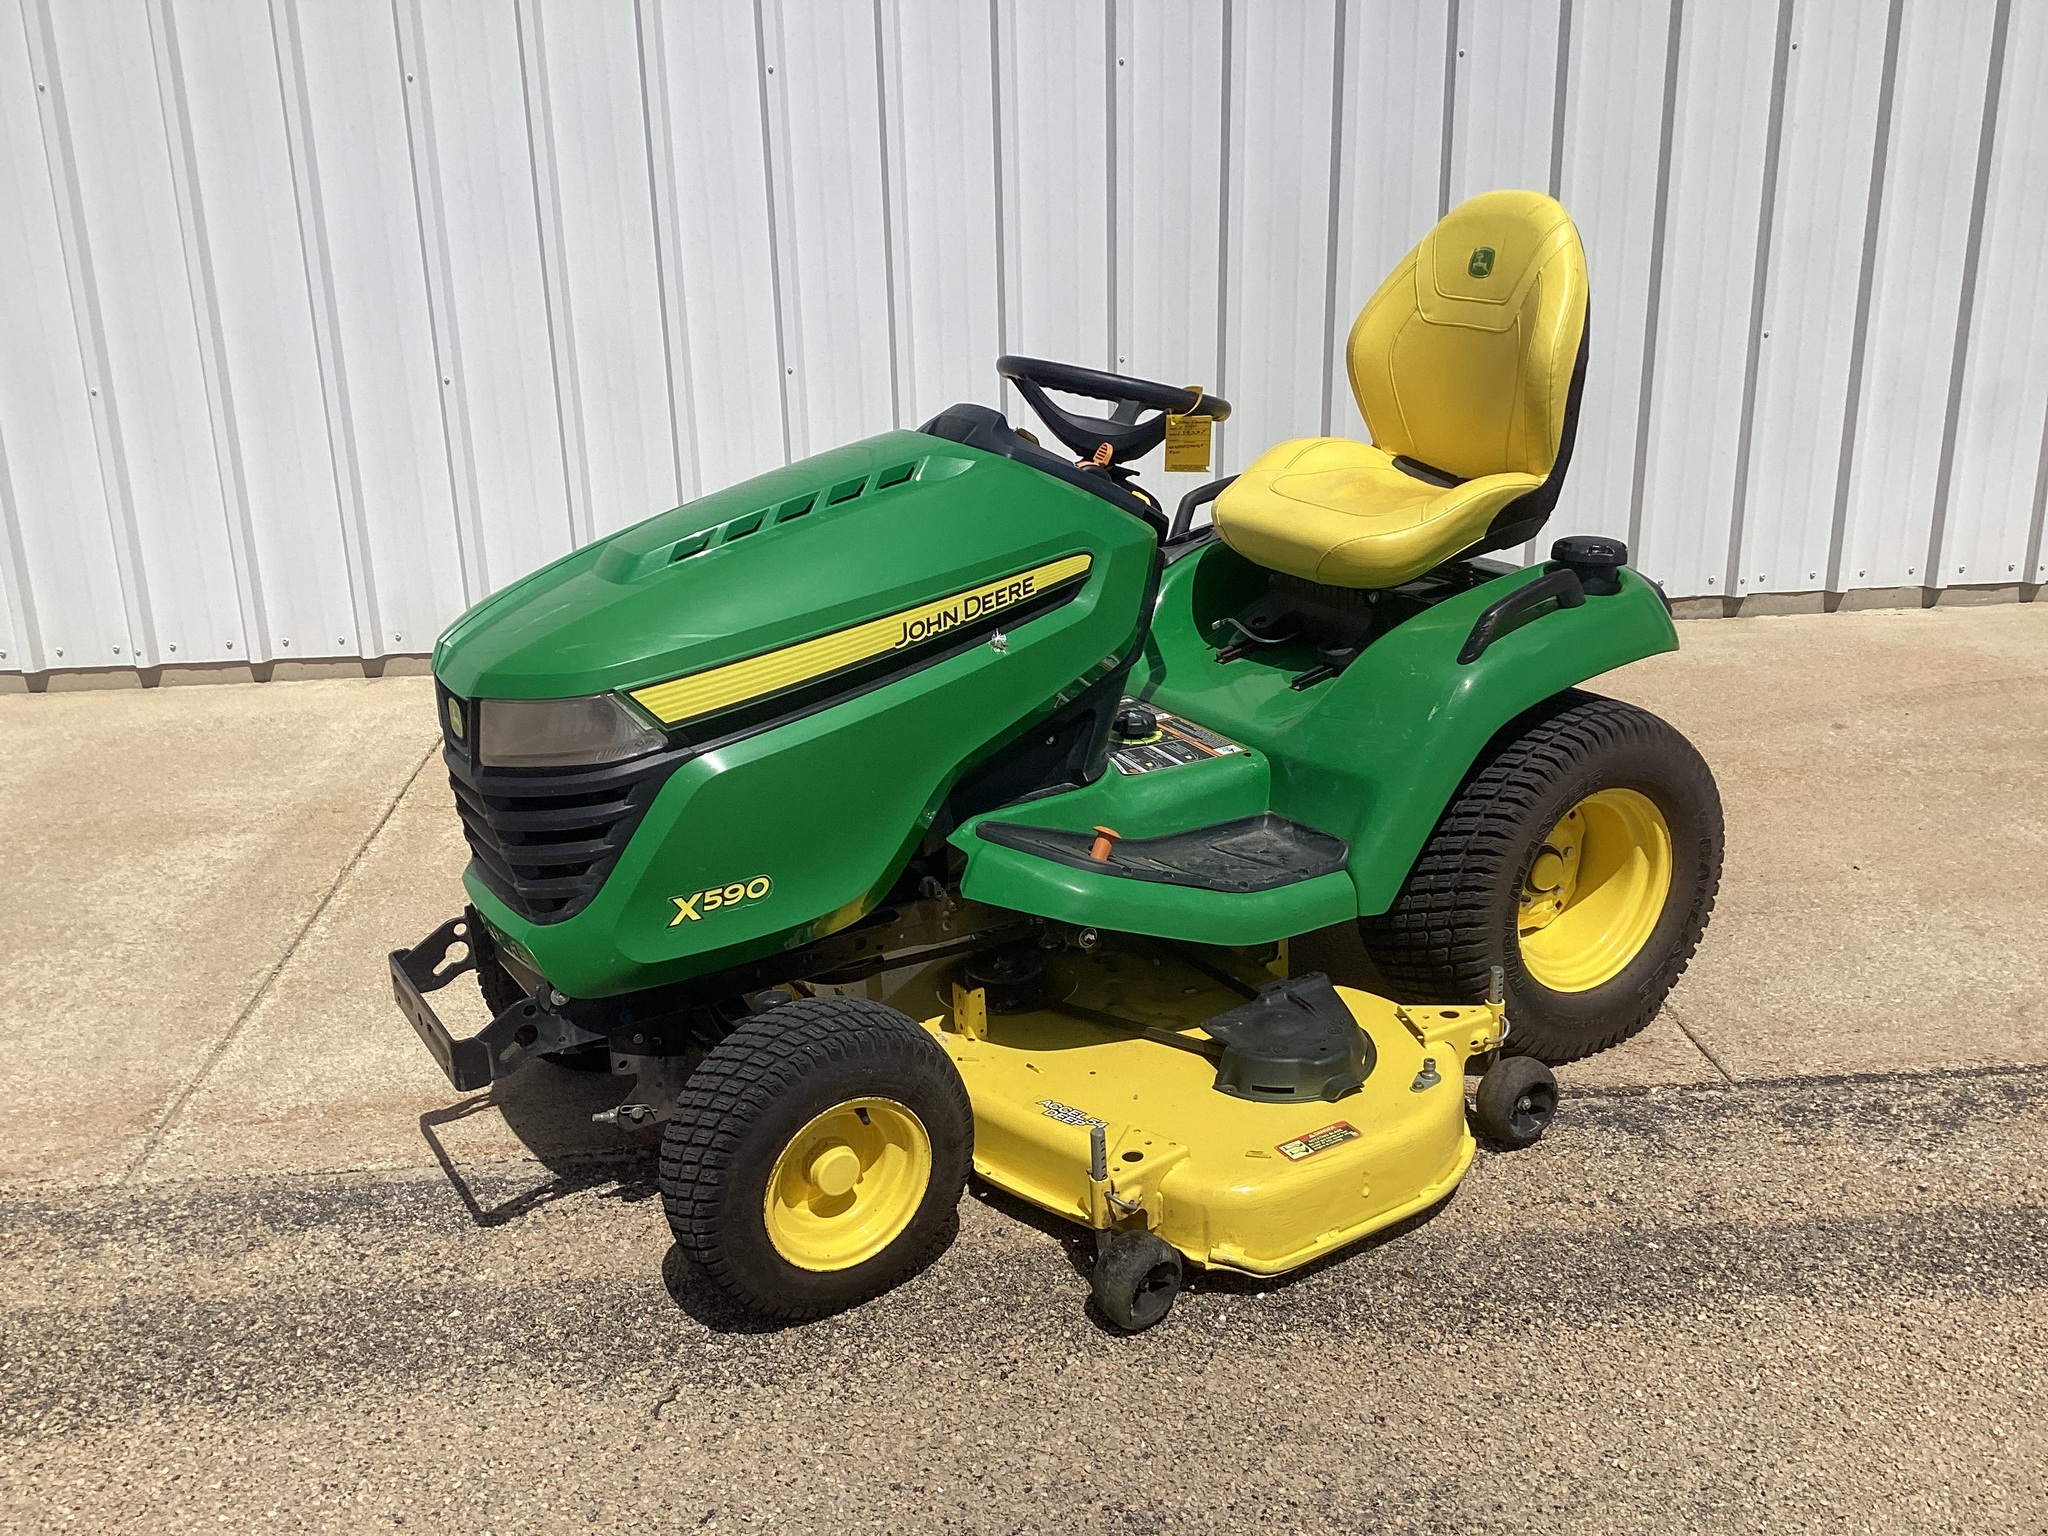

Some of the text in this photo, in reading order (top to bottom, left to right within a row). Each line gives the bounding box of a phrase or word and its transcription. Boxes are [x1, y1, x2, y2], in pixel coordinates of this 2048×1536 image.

[895, 576, 1036, 648] JOHN DEERE
[1508, 767, 1604, 903] MASTER
[667, 875, 771, 928] X590
[1637, 837, 1712, 1005] CARLISLE
[1035, 1099, 1109, 1129] ACCEL 54
[1042, 1109, 1086, 1127] DEEP
